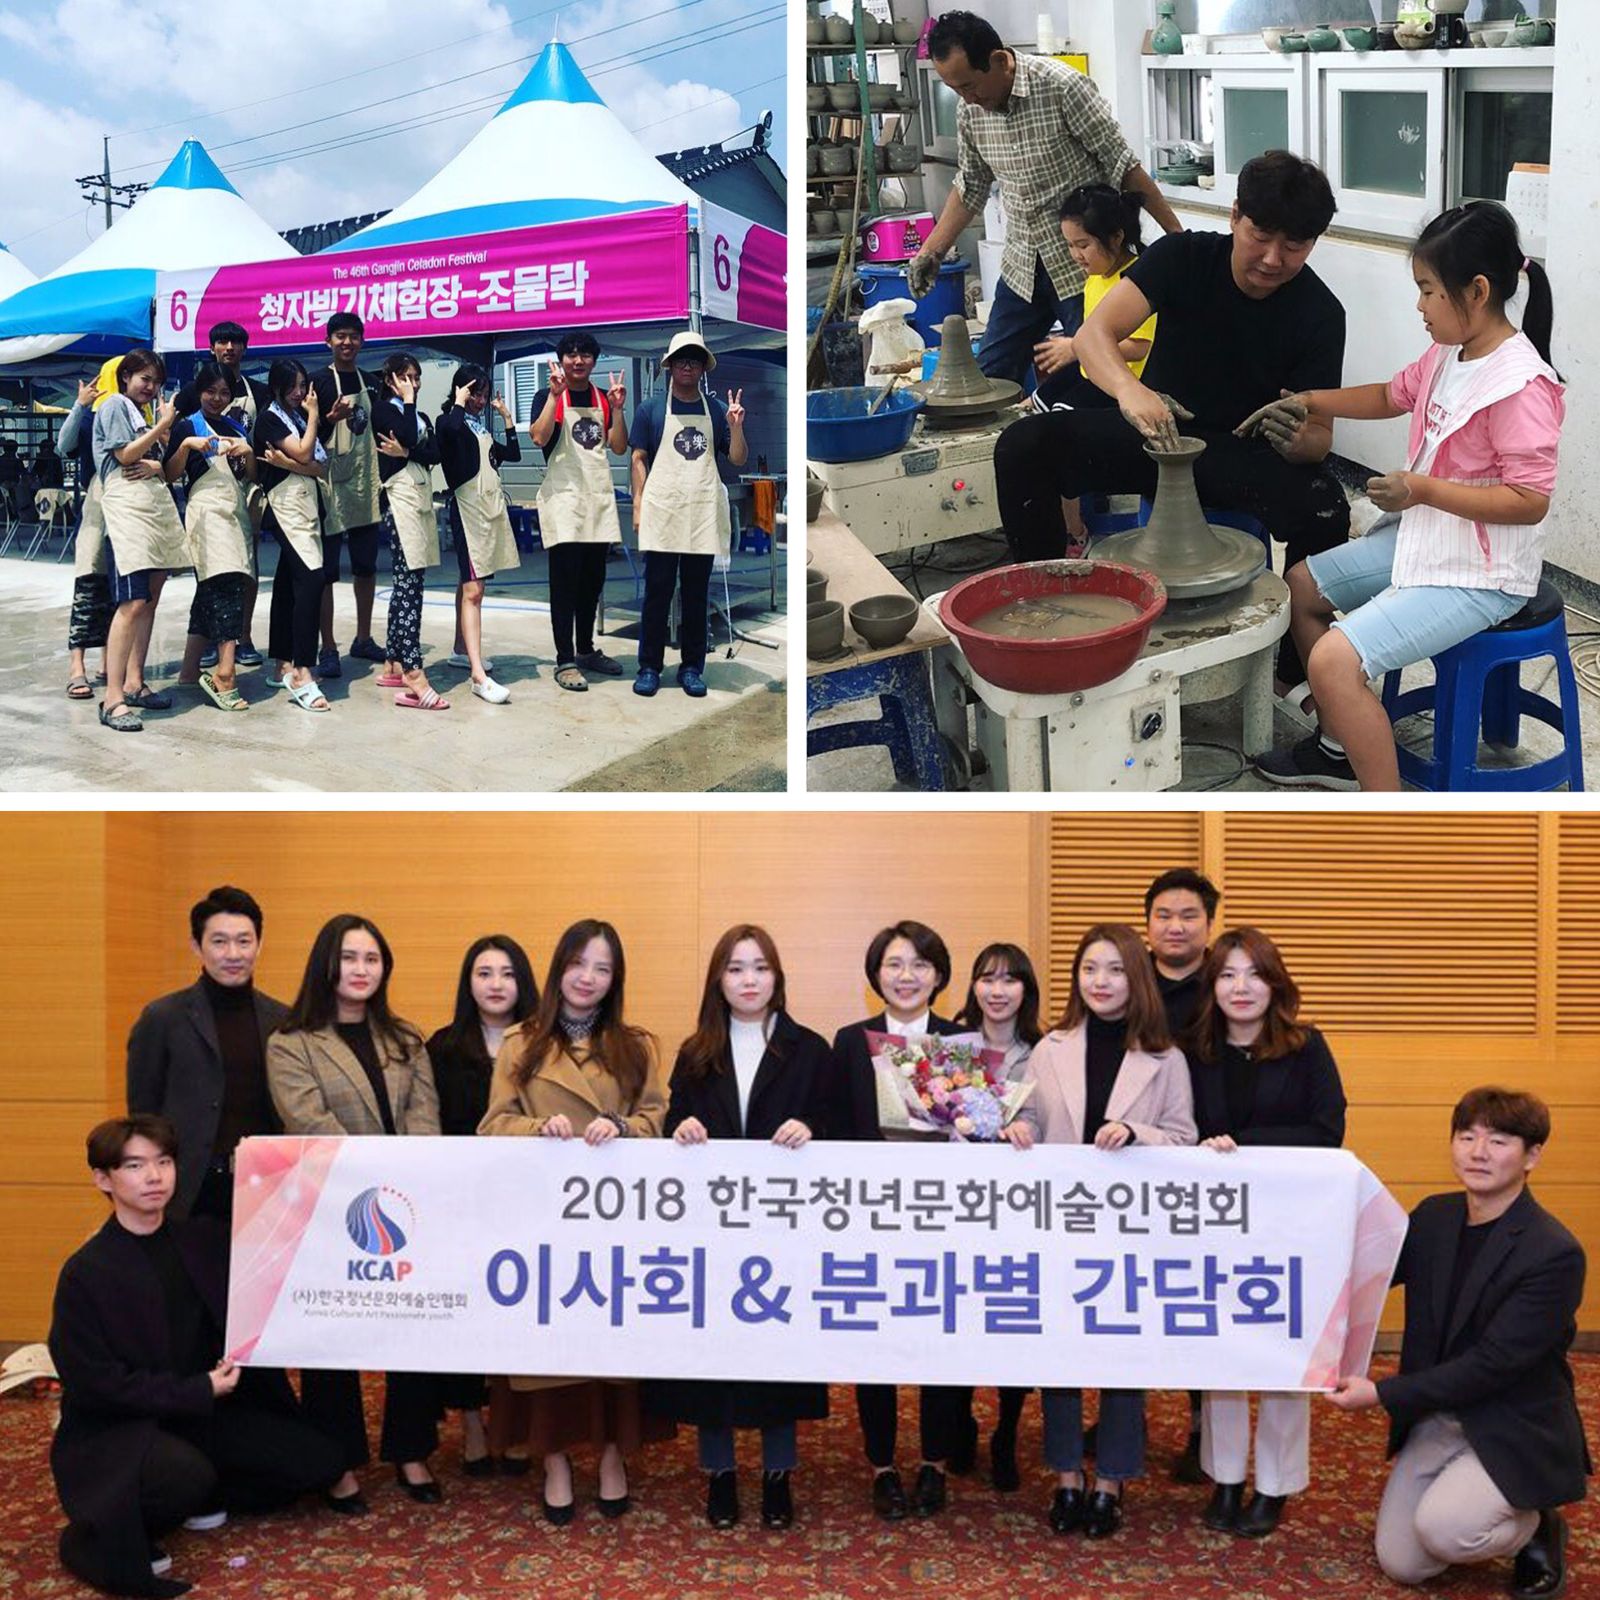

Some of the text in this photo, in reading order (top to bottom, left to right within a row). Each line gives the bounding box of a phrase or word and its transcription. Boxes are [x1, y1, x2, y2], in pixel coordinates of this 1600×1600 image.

[332, 250, 488, 280] The 46th Gangjin Celadon Festival
[714, 234, 731, 292] 6
[170, 289, 188, 332] 6
[562, 1175, 1249, 1236] 2018 한국청년문화예술인협회
[347, 1259, 413, 1282] KCAP
[486, 1243, 1303, 1340] 이사회 & 분과별 간담회
[292, 1288, 468, 1309] (사)한국청년문화예술인협회
